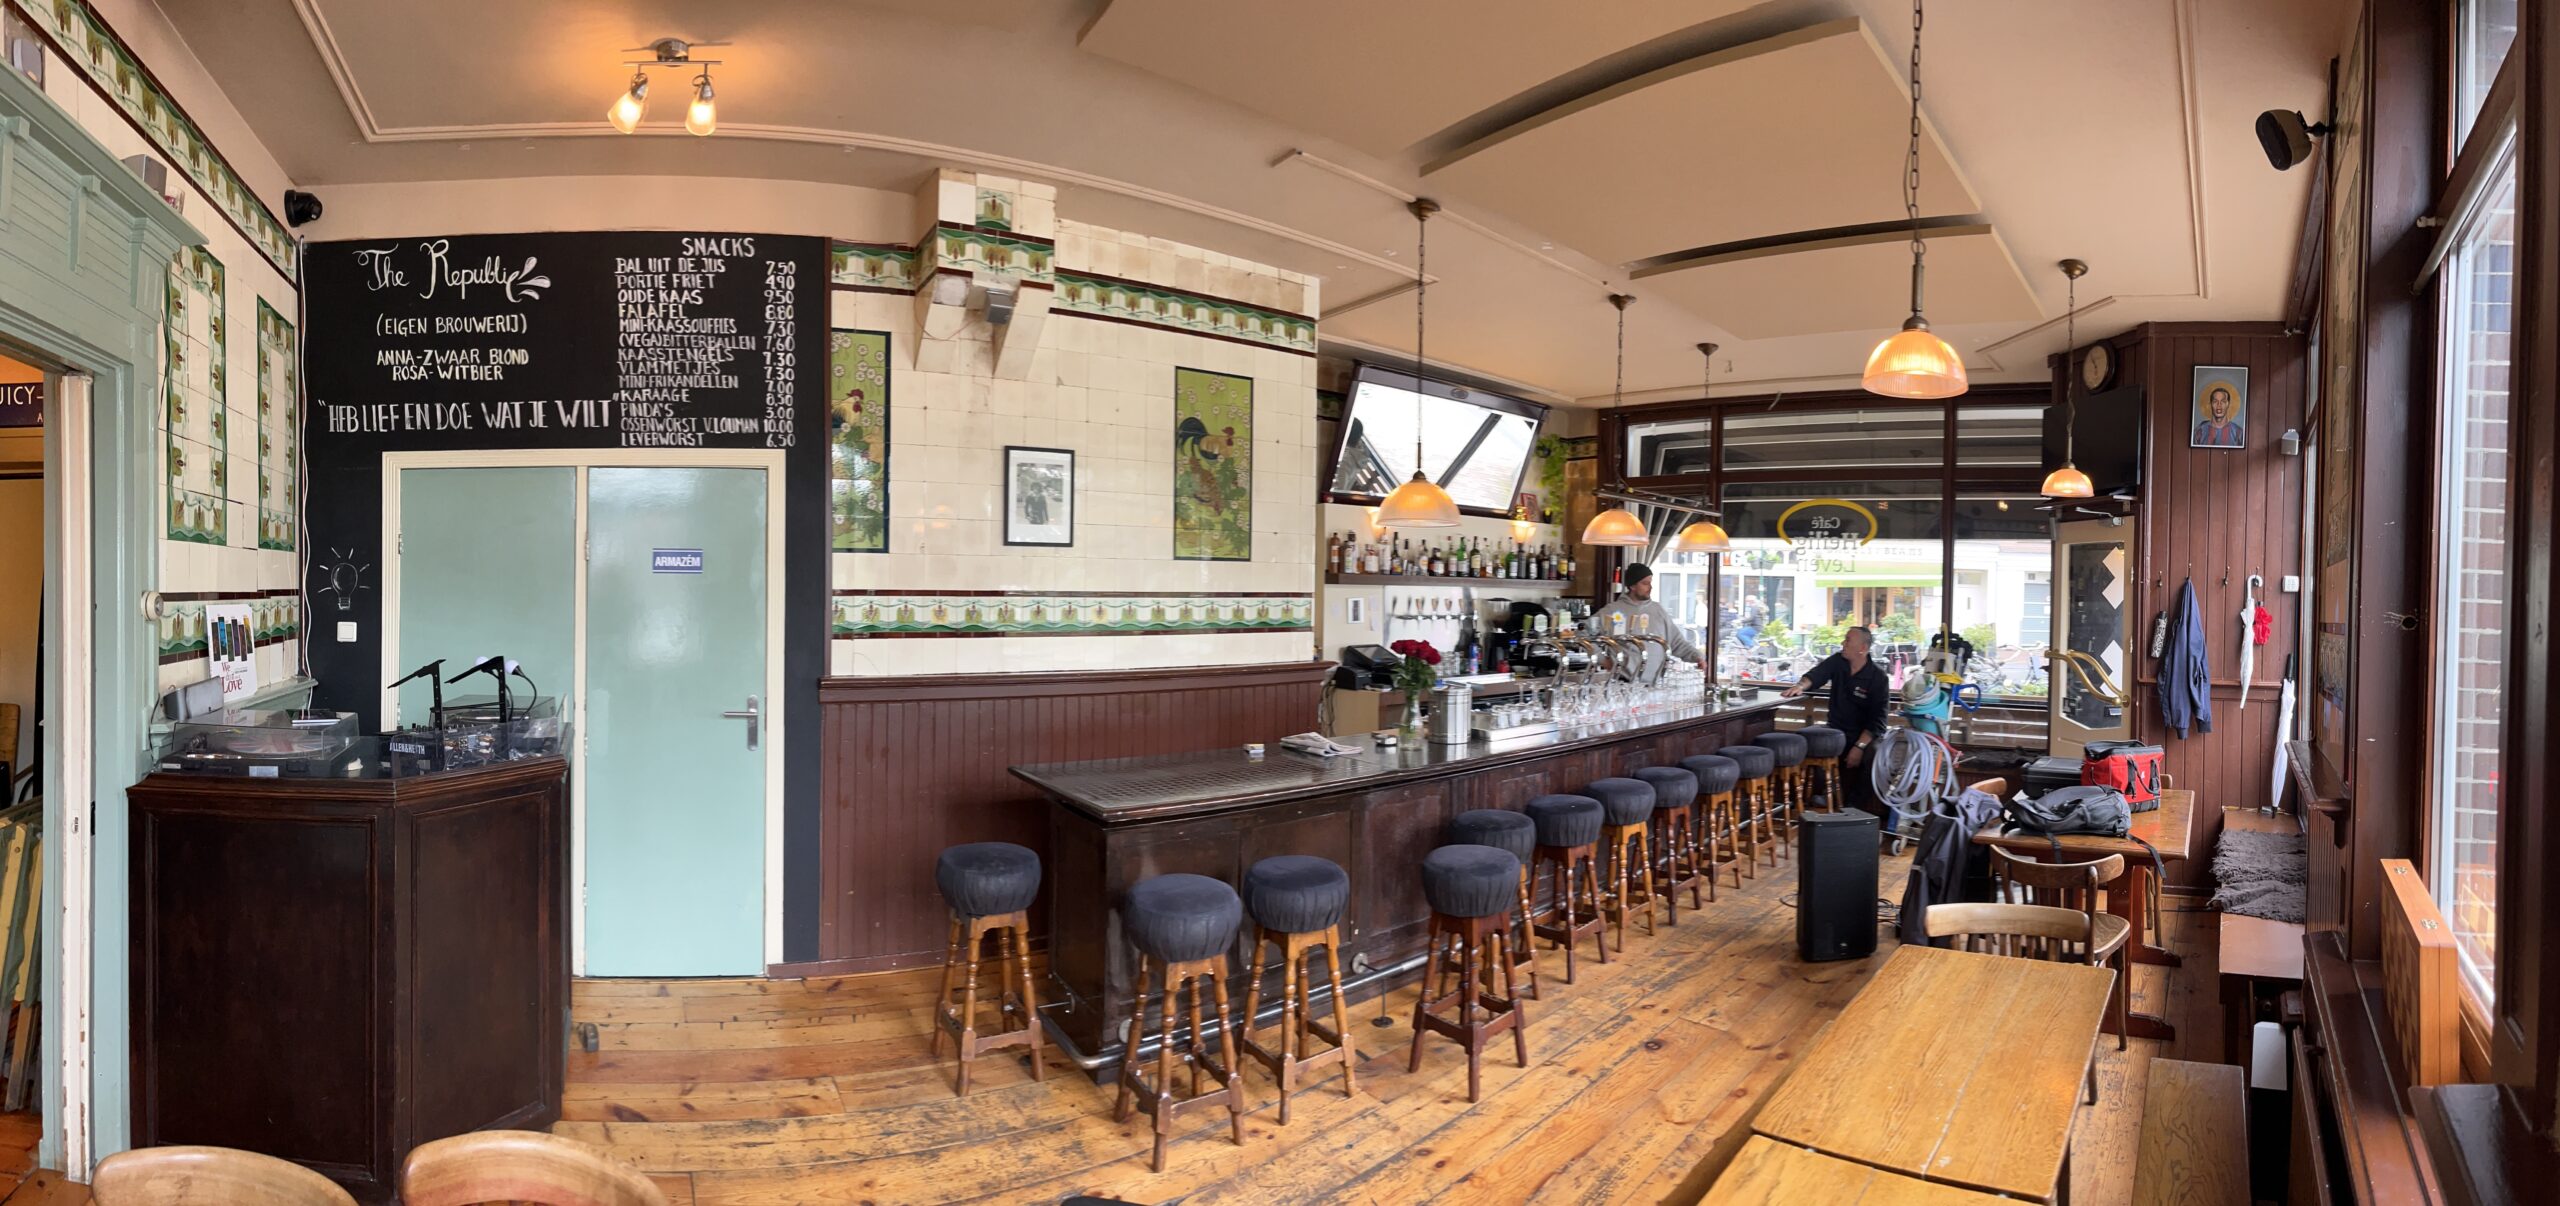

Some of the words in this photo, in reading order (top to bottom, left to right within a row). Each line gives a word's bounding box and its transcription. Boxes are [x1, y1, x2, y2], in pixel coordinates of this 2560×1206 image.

[681, 237, 756, 257] SNACKS
[352, 243, 410, 291] The
[419, 239, 523, 303] Republic
[615, 257, 644, 274] BAL
[648, 257, 671, 273] UIT
[678, 257, 696, 273] DE
[700, 257, 726, 273] JUS
[765, 260, 796, 276] 7.50
[615, 273, 667, 289] PORTIE
[672, 273, 716, 289] FRIET
[617, 288, 655, 303] OUDE
[658, 288, 704, 305] KAAS
[618, 302, 687, 319] FALAFEL
[376, 313, 427, 337] (EIGEN
[435, 312, 528, 334] BROUWERIJ)
[376, 350, 481, 366] ANNA-ZWAAR
[489, 349, 530, 365] BLOND
[617, 347, 735, 362] KAASSTENGELS
[616, 360, 721, 375] VLAMMETJES
[618, 374, 739, 389] MINI-FRIKANDELLEN
[619, 388, 692, 403] KARAAGE
[361, 403, 400, 432] LIEF
[403, 402, 431, 431] EN
[434, 401, 473, 431] DOE
[480, 401, 524, 429] WAT
[527, 400, 549, 428] JE
[619, 402, 674, 418] PINDA'S
[620, 416, 697, 433] OSSENWORST
[763, 418, 794, 433] 10.00
[621, 432, 705, 447] LEVERWORST
[765, 433, 796, 448] 6.50
[655, 554, 701, 567] ARMAZÉM
[220, 677, 243, 694] Love
